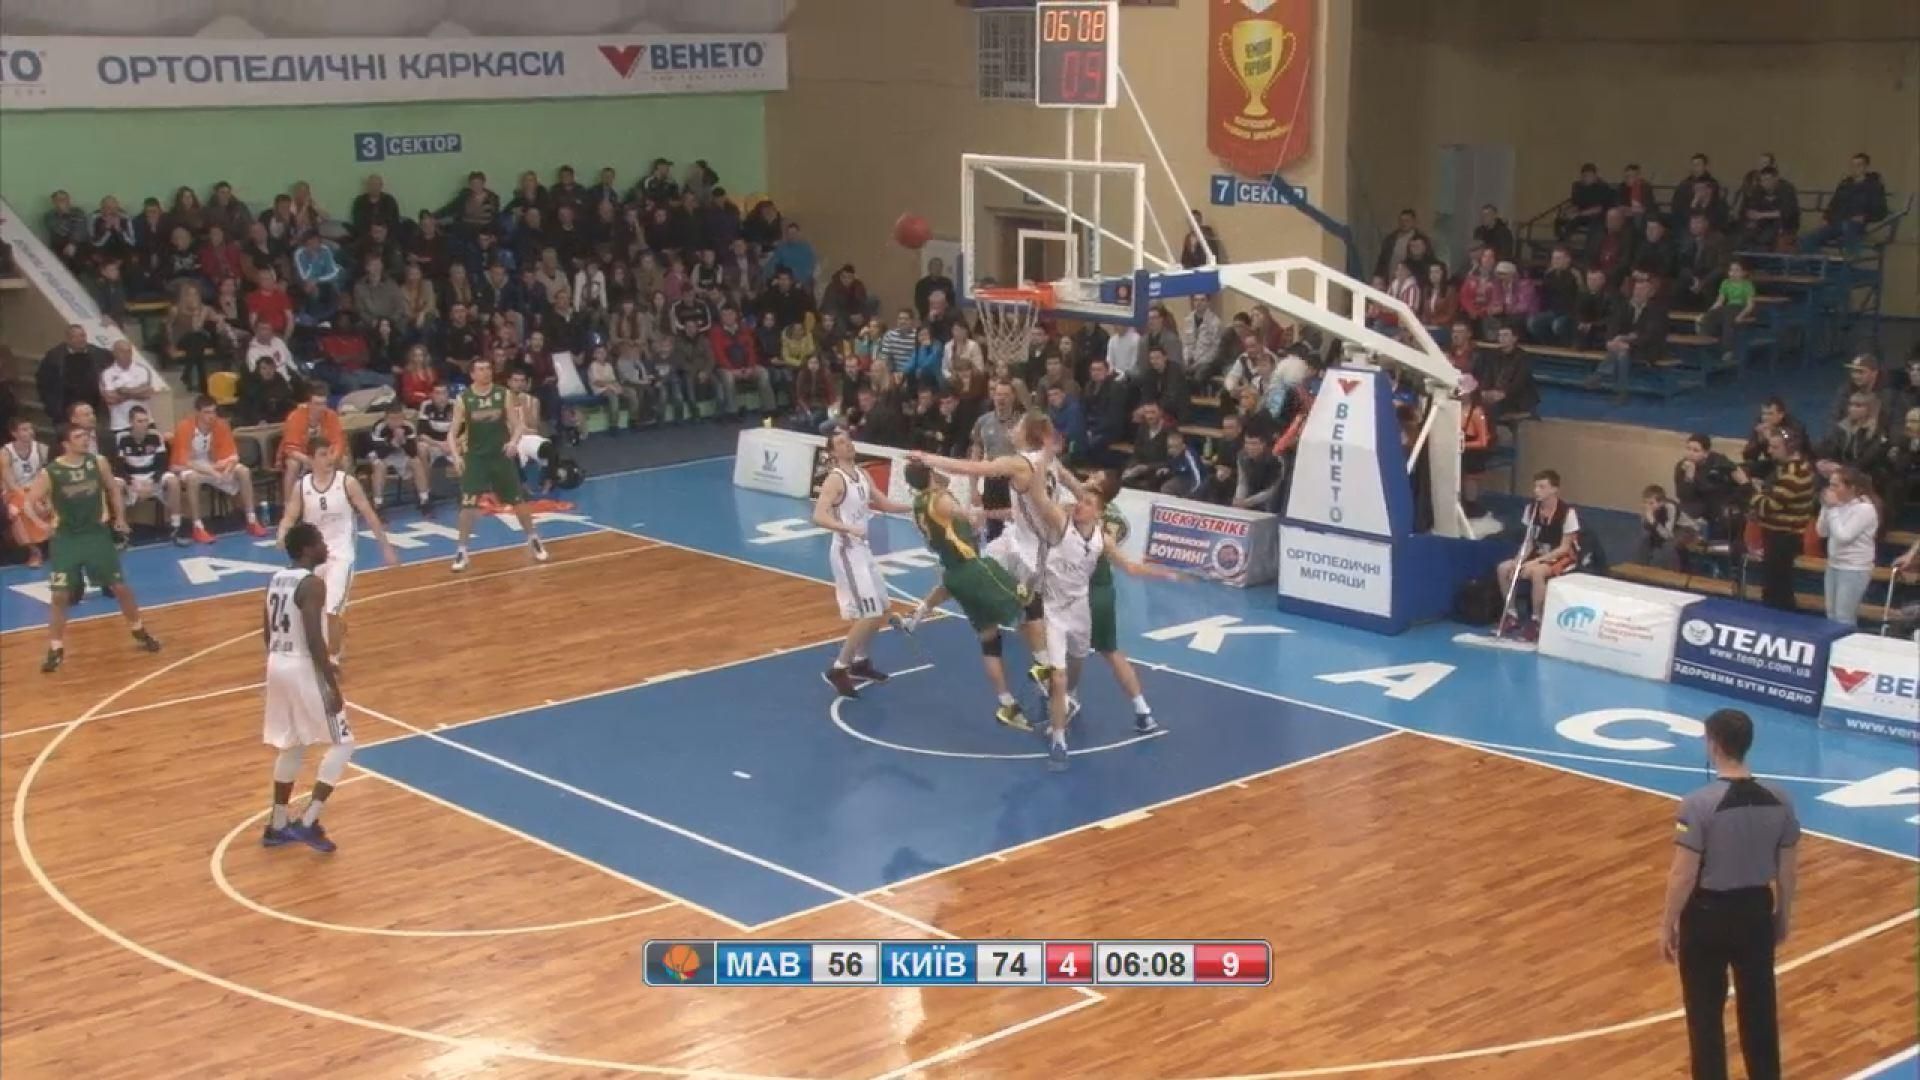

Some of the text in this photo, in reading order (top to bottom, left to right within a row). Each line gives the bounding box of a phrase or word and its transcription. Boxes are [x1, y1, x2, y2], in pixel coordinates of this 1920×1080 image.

[98, 50, 565, 84] ОРТОПЕДИЧНІ КАРКАСИ
[650, 41, 763, 70] ВЕНЕТО
[362, 135, 458, 157] 3 СЕКТОР
[1216, 180, 1229, 201] 7
[1330, 402, 1349, 523] ВЕНЕТО
[1199, 517, 1249, 537] STRIKE
[1149, 543, 1208, 565] БОУЛИНГ
[1286, 548, 1381, 575] ОРТОПЕДИЧНІ
[1300, 566, 1366, 589] МАТРАЦИ
[270, 593, 291, 634] 24
[1714, 623, 1816, 666] ТЕМП
[1709, 647, 1811, 678] www.temp.com.ua
[1674, 662, 1813, 704] ЗДОРОВИМ БУТИ МОДНО
